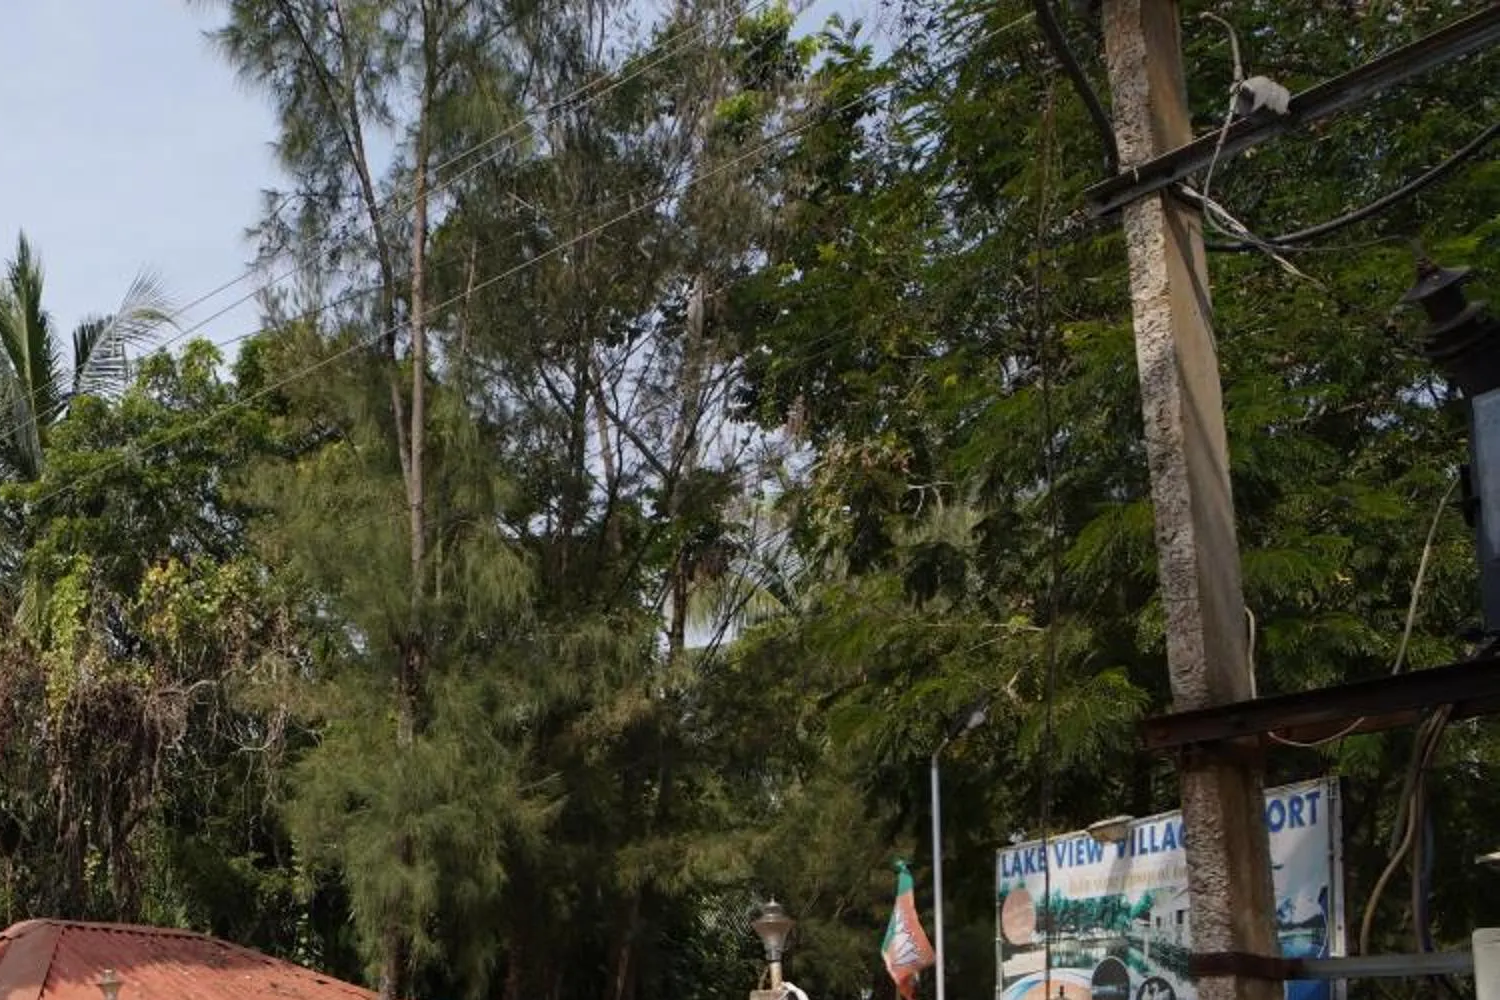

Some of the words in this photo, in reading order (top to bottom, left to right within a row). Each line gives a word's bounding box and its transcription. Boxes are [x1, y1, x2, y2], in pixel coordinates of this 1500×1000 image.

[1002, 845, 1047, 877] LAKE
[1055, 837, 1104, 868] VIEW
[1116, 822, 1187, 859] ILLA
[1265, 791, 1320, 832] ORT
